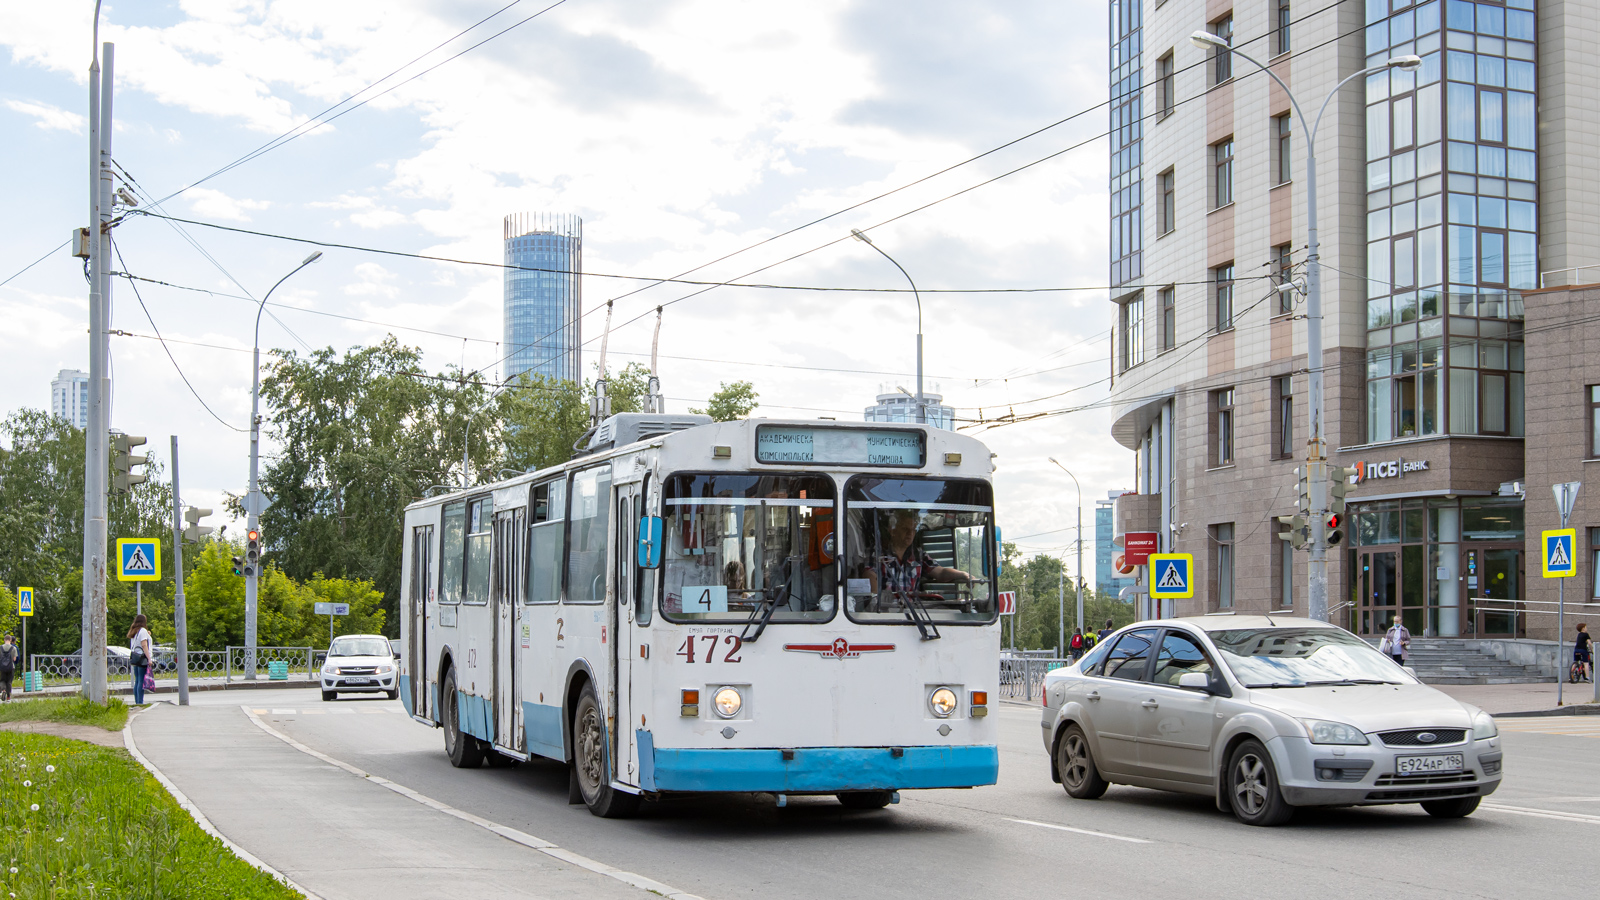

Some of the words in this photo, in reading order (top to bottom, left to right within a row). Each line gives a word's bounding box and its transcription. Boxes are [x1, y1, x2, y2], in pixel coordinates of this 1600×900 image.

[868, 454, 904, 464] СУЛИМОВА
[1367, 461, 1398, 479] ПСБ
[1403, 460, 1429, 472] БАНК
[698, 588, 711, 611] 4
[557, 618, 564, 641] 2
[676, 635, 742, 663] 472
[1446, 756, 1461, 766] 196
